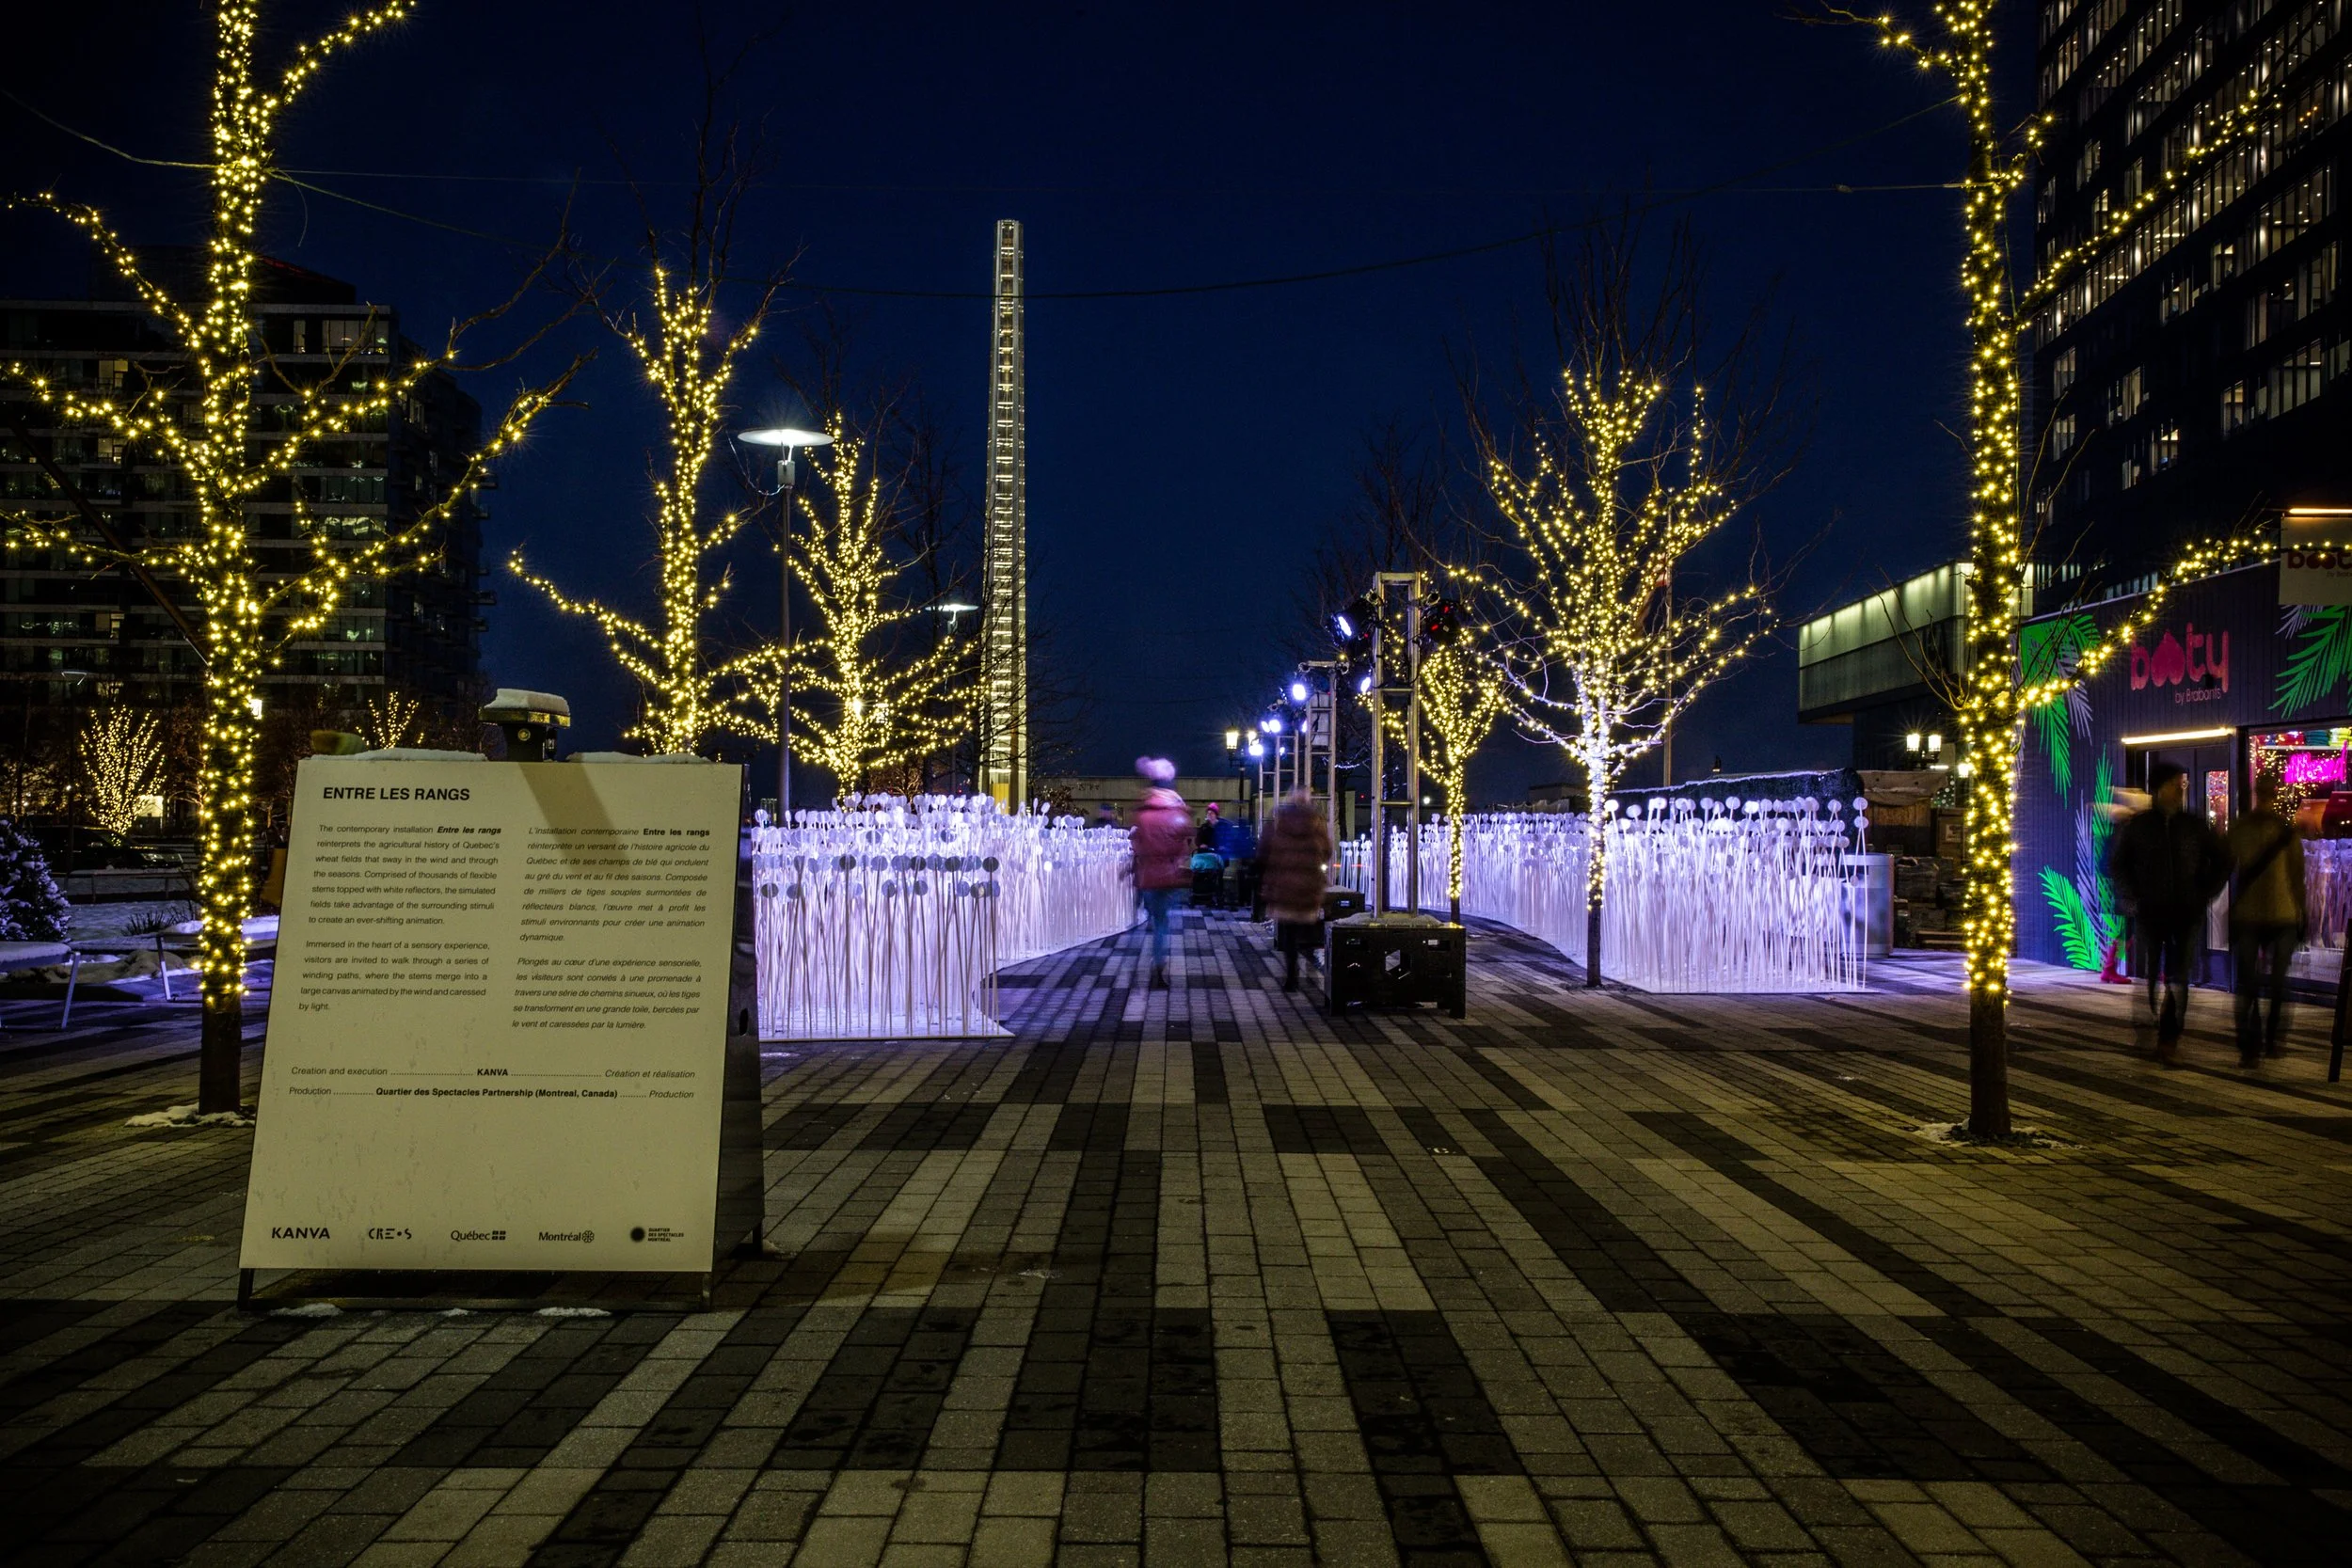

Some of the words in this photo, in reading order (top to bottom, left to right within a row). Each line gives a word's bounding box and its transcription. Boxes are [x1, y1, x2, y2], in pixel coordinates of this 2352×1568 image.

[2175, 690, 2185, 705] by
[323, 787, 375, 800] ENTRE
[379, 787, 410, 800] LES
[414, 788, 470, 800] RANGS
[319, 824, 334, 833] The
[336, 825, 390, 835] contemporary
[392, 825, 434, 833] installation
[437, 825, 460, 834] Entre
[462, 826, 475, 834] les
[477, 828, 501, 836] rangs
[528, 827, 577, 835] L'installation
[580, 827, 639, 838] contemporaine
[643, 828, 666, 836] Entre
[669, 828, 682, 836] les
[686, 830, 710, 838] rangs
[316, 840, 361, 850] reinterprets
[363, 840, 376, 848] the
[378, 840, 422, 851] agricultural
[423, 841, 450, 851] history
[452, 841, 461, 849] of
[462, 841, 500, 850] Quebec's
[315, 855, 339, 863] wheat
[341, 855, 362, 863] fields
[364, 855, 380, 863] that
[382, 857, 403, 865] sway
[405, 855, 412, 863] in
[414, 855, 427, 863] the
[429, 855, 449, 864] wind
[451, 856, 467, 864] and
[469, 856, 499, 866] through
[313, 869, 326, 878] the
[364, 870, 407, 880] Comprised
[408, 870, 417, 879] of
[418, 870, 459, 879] thousands
[460, 871, 469, 879] of
[469, 871, 498, 879] flexible
[311, 885, 335, 894] stems
[336, 885, 365, 895] topped
[366, 885, 382, 894] with
[383, 885, 404, 894] white
[405, 885, 443, 895] reflectors,
[444, 886, 457, 895] the
[458, 886, 496, 895] simulated
[523, 886, 534, 895] de
[538, 887, 566, 895] milliers
[570, 887, 582, 895] de
[586, 887, 606, 897] tiges
[610, 887, 642, 898] souples
[645, 888, 691, 896] surmontées
[695, 888, 707, 896] de
[310, 899, 331, 909] fields
[333, 900, 351, 909] take
[352, 900, 394, 911] advantage
[396, 900, 405, 909] of
[405, 900, 419, 909] the
[421, 901, 468, 911] surrounding
[469, 901, 495, 910] stimuli
[521, 902, 564, 911] réflecteurs
[568, 903, 597, 912] blancs,
[637, 903, 653, 911] met
[657, 903, 663, 911] à
[668, 903, 690, 914] profit
[693, 904, 707, 912] les
[308, 915, 317, 924] to
[317, 915, 343, 924] create
[356, 915, 405, 926] ever-shifting
[405, 916, 445, 925] animation.
[520, 917, 547, 926] stimuli
[548, 918, 599, 927] environnants
[602, 920, 621, 928] pour
[624, 918, 645, 927] créer
[666, 918, 706, 927] animation
[519, 933, 565, 943] dynamique.
[306, 940, 346, 949] Immersed
[347, 941, 356, 949] in
[357, 941, 370, 949] the
[371, 941, 392, 949] heart
[393, 941, 403, 949] of
[411, 942, 442, 952] sensory
[444, 942, 490, 952] experience,
[304, 955, 332, 964] visitors
[351, 956, 378, 964] invited
[380, 956, 389, 964] to
[391, 956, 410, 964] walk
[412, 956, 443, 967] through
[454, 957, 479, 965] series
[481, 957, 489, 965] of
[516, 958, 549, 968] Plongés
[587, 958, 611, 967] d'une
[612, 958, 656, 969] expérience
[658, 958, 702, 969] sensorielle,
[302, 971, 334, 982] winding
[336, 972, 361, 982] paths,
[364, 972, 389, 980] where
[391, 972, 405, 980] the
[408, 972, 433, 980] stems
[435, 974, 461, 983] merge
[464, 972, 479, 981] into
[516, 973, 528, 981] les
[531, 973, 564, 981] visiteurs
[566, 974, 583, 982] sont
[586, 974, 617, 982] conviés
[620, 974, 626, 982] à
[646, 974, 692, 985] promenade
[695, 974, 702, 983] à
[298, 1002, 309, 1012] by
[310, 1002, 330, 1012] light.
[512, 1019, 519, 1027] le
[520, 1019, 538, 1027] vent
[539, 1020, 548, 1028] et
[548, 1020, 590, 1028] caressées
[591, 1022, 605, 1030] par
[606, 1020, 614, 1028] la
[291, 1066, 327, 1075] Creation
[328, 1066, 345, 1075] and
[346, 1066, 388, 1075] execution
[476, 1068, 509, 1077] KANVA
[604, 1069, 641, 1078] Création
[642, 1069, 651, 1078] et
[652, 1069, 696, 1078] réalisation
[289, 1085, 332, 1095] Production
[375, 1086, 413, 1097] Quartier
[414, 1086, 431, 1096] des
[431, 1087, 481, 1099] Spectacles
[482, 1087, 534, 1100] Partnership
[534, 1088, 580, 1100] (Montreal,
[580, 1088, 618, 1101] Canada)
[648, 1089, 694, 1099] Production
[271, 1227, 330, 1240] KANVA
[450, 1229, 490, 1242] Québec
[538, 1230, 581, 1242] Montréal
